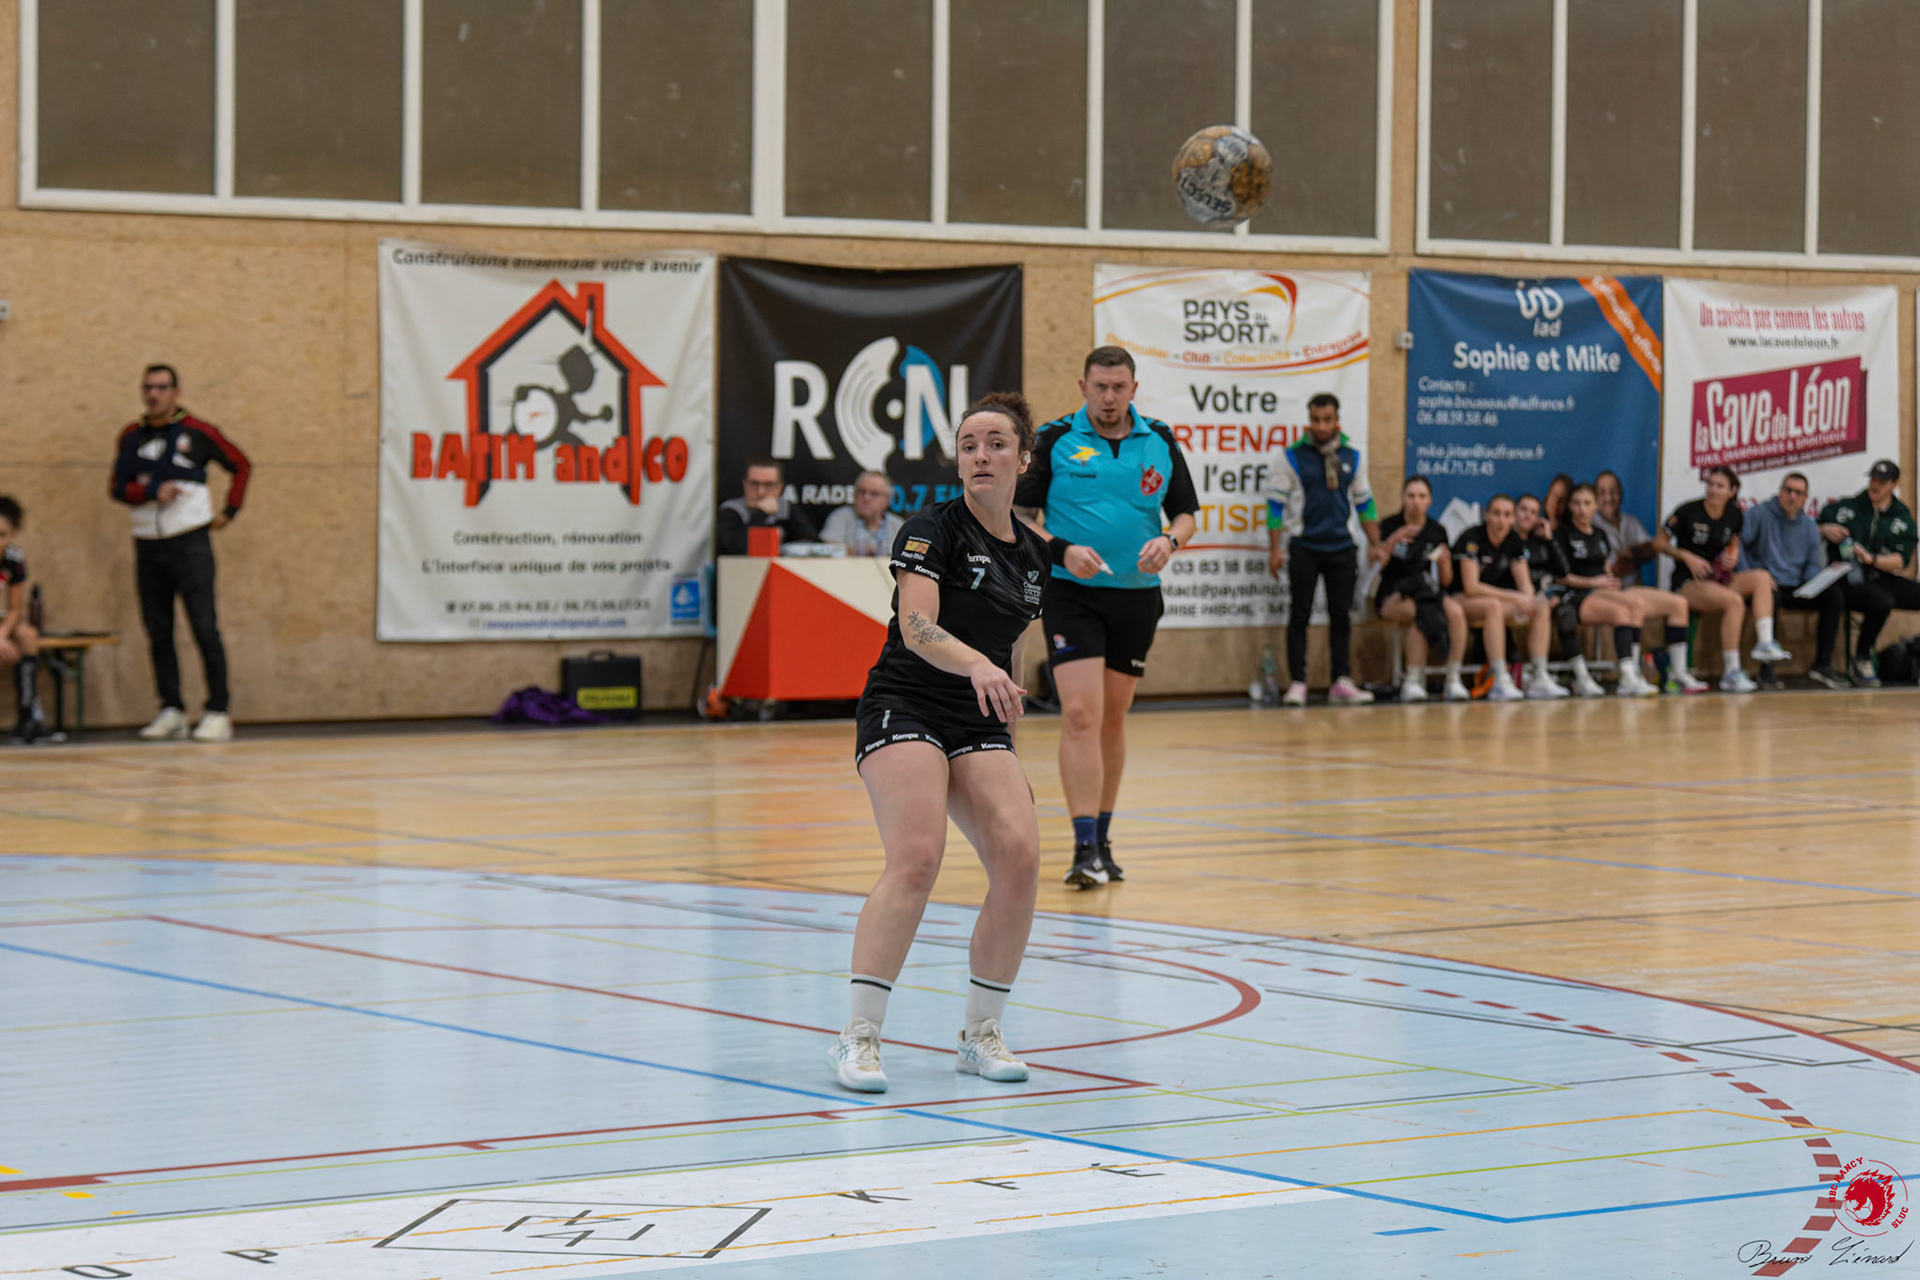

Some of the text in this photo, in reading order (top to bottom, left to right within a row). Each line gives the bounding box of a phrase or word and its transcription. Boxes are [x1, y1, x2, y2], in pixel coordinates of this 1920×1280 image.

[602, 258, 646, 273] votre
[649, 257, 703, 273] avenir
[1183, 300, 1250, 322] PAYS
[1700, 301, 1714, 328] Un
[1753, 307, 1772, 332] pas
[1774, 308, 1810, 331] comme
[1812, 303, 1829, 331] les
[1831, 305, 1866, 332] autres
[1183, 322, 1270, 343] SPORT
[1532, 317, 1562, 338] iad
[1727, 335, 1841, 351] www.lacavedeleon.fr
[1181, 350, 1211, 363] Club
[1453, 341, 1622, 376] Sophie et Mike
[1417, 375, 1467, 393] Contacts
[1189, 383, 1278, 414] Votre
[1705, 380, 1773, 451] Cave
[1771, 406, 1789, 441] de
[1787, 365, 1852, 437] Léon
[1172, 424, 1303, 453] RTENAI
[411, 431, 690, 483] BATIM and CO
[1204, 463, 1269, 493] l'eff
[783, 484, 799, 505] A
[890, 483, 928, 513] 0.7
[453, 530, 643, 547] Construction, rénovation
[421, 558, 673, 576] L'interface unique de vos projets
[967, 552, 992, 565] empa
[1170, 560, 1195, 576] 03
[891, 559, 940, 580] mpa Kempa
[970, 567, 986, 590] 7
[865, 738, 887, 753] Kempa
[892, 733, 920, 742] Kempa
[980, 742, 1008, 750] Kempa
